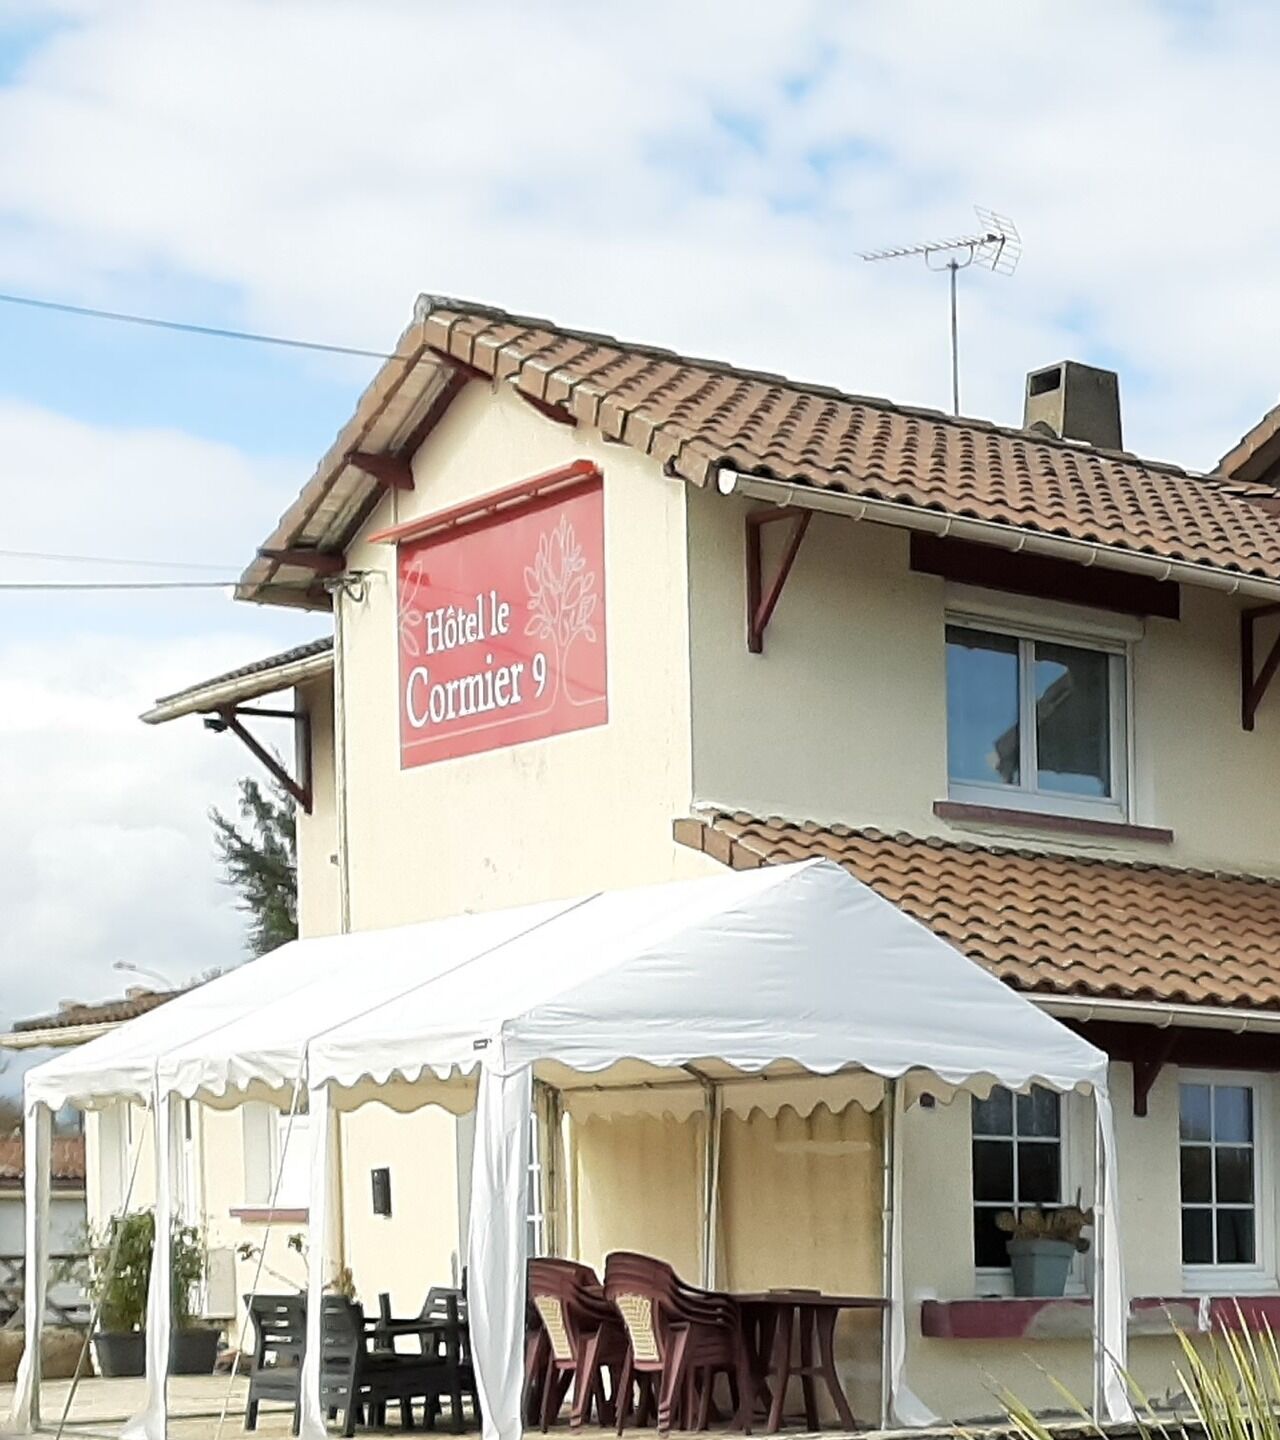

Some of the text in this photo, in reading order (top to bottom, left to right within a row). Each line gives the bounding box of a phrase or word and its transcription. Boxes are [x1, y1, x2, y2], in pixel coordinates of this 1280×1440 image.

[425, 590, 510, 654] Hôtel le
[406, 653, 546, 729] Cormier 9
